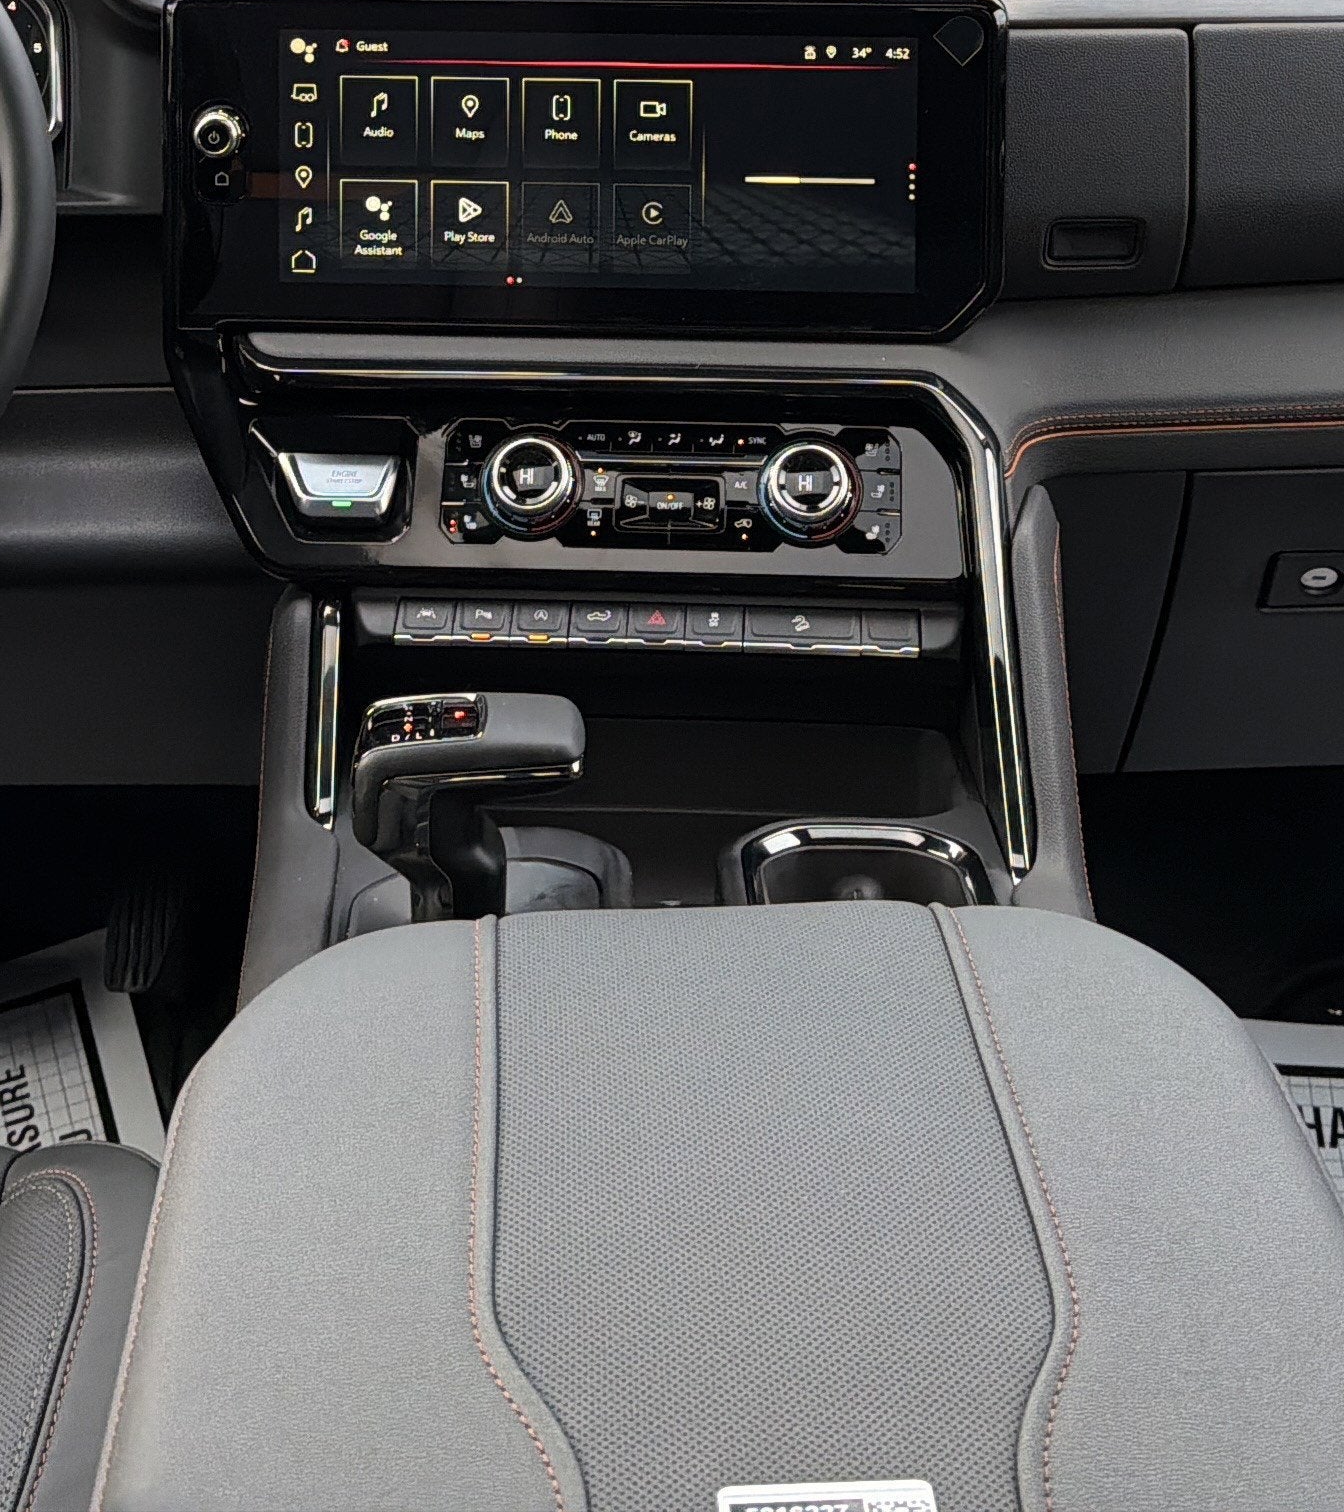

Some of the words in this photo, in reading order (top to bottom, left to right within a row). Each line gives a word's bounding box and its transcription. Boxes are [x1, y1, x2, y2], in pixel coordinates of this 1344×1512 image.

[7, 0, 17, 12] 4
[32, 42, 43, 54] 5
[356, 41, 388, 52] Guest
[851, 47, 872, 59] 34°
[885, 48, 910, 60] 4:52
[363, 127, 394, 138] Audio
[455, 128, 485, 141] Maps
[545, 129, 578, 141] Phone
[629, 130, 676, 142] Cameras
[359, 229, 398, 243] Google
[444, 230, 466, 244] Play
[467, 230, 496, 243] Store
[526, 232, 567, 243] Android
[569, 233, 594, 244] Auto
[616, 234, 646, 248] Apple
[648, 235, 689, 248] CarPlay
[354, 244, 403, 256] Assistant
[587, 432, 606, 443] AUTO
[748, 436, 767, 446] SYNC
[331, 469, 358, 478] ENGINE
[734, 479, 748, 490] A/C
[656, 500, 684, 512] ON/OFF
